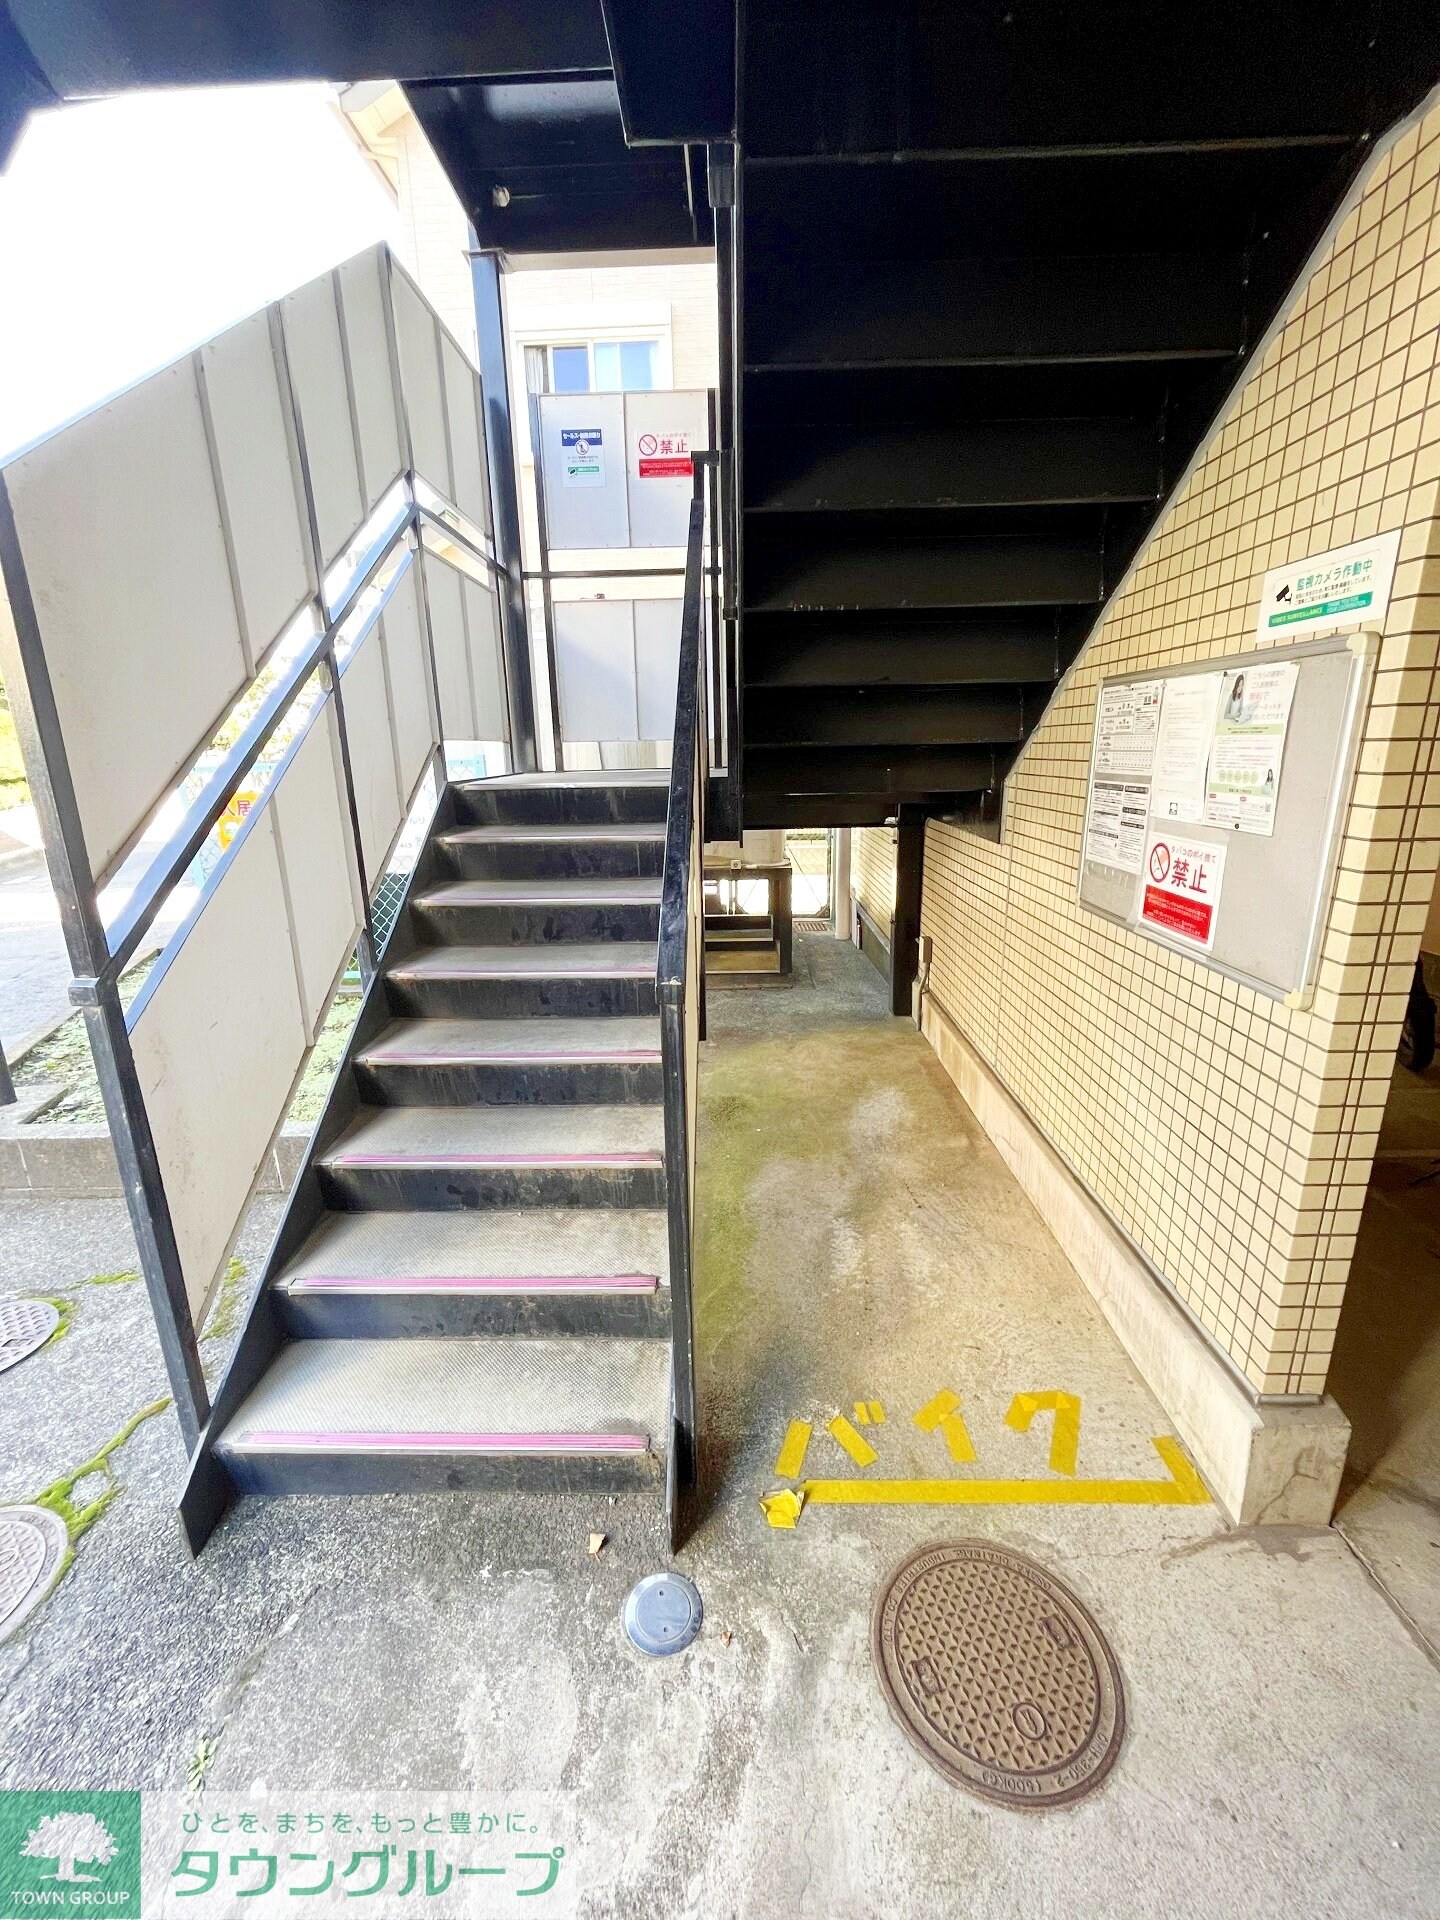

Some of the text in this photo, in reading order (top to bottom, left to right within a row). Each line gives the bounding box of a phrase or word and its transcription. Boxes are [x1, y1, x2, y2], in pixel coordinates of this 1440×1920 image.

[660, 439, 689, 454] 禁止
[1296, 558, 1372, 591] 監視カメラ作動中
[1171, 846, 1217, 864] タバコのポイ捨て
[1171, 857, 1207, 893] 禁止
[774, 1387, 1082, 1479] バイク
